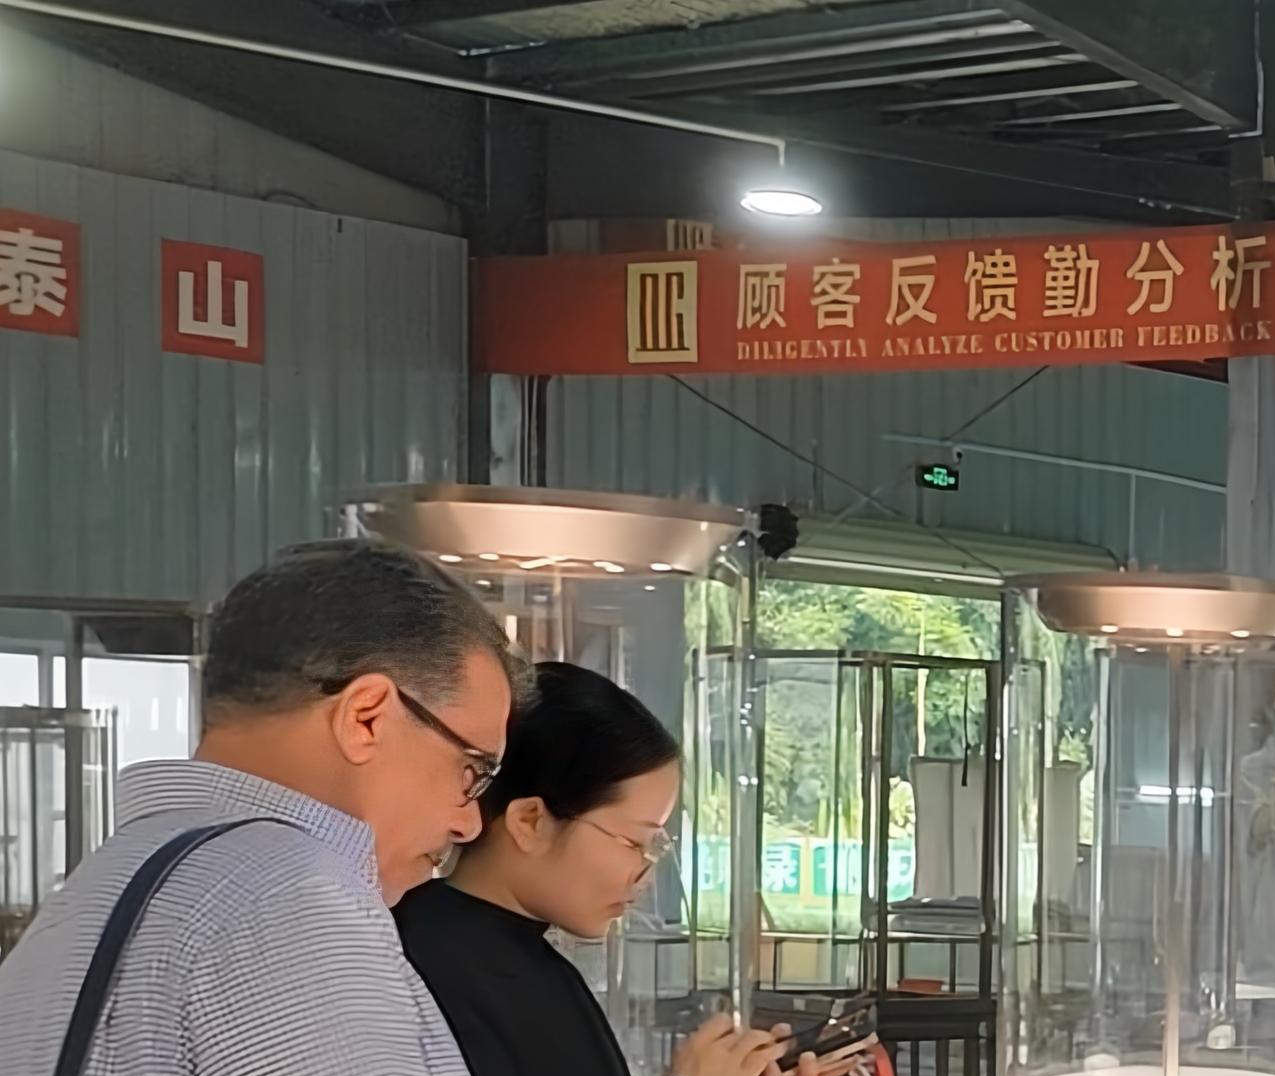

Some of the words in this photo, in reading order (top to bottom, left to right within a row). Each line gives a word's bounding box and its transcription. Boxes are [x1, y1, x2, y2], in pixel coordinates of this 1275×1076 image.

[0, 227, 67, 318] 泰
[178, 260, 249, 348] 山
[737, 235, 1272, 330] 顾客反馈勤分析
[737, 338, 868, 360] DILIGENTLY
[880, 334, 984, 357] ANALYZE
[993, 327, 1125, 353] CUSTOMER
[1136, 320, 1273, 347] FEEDBACK
